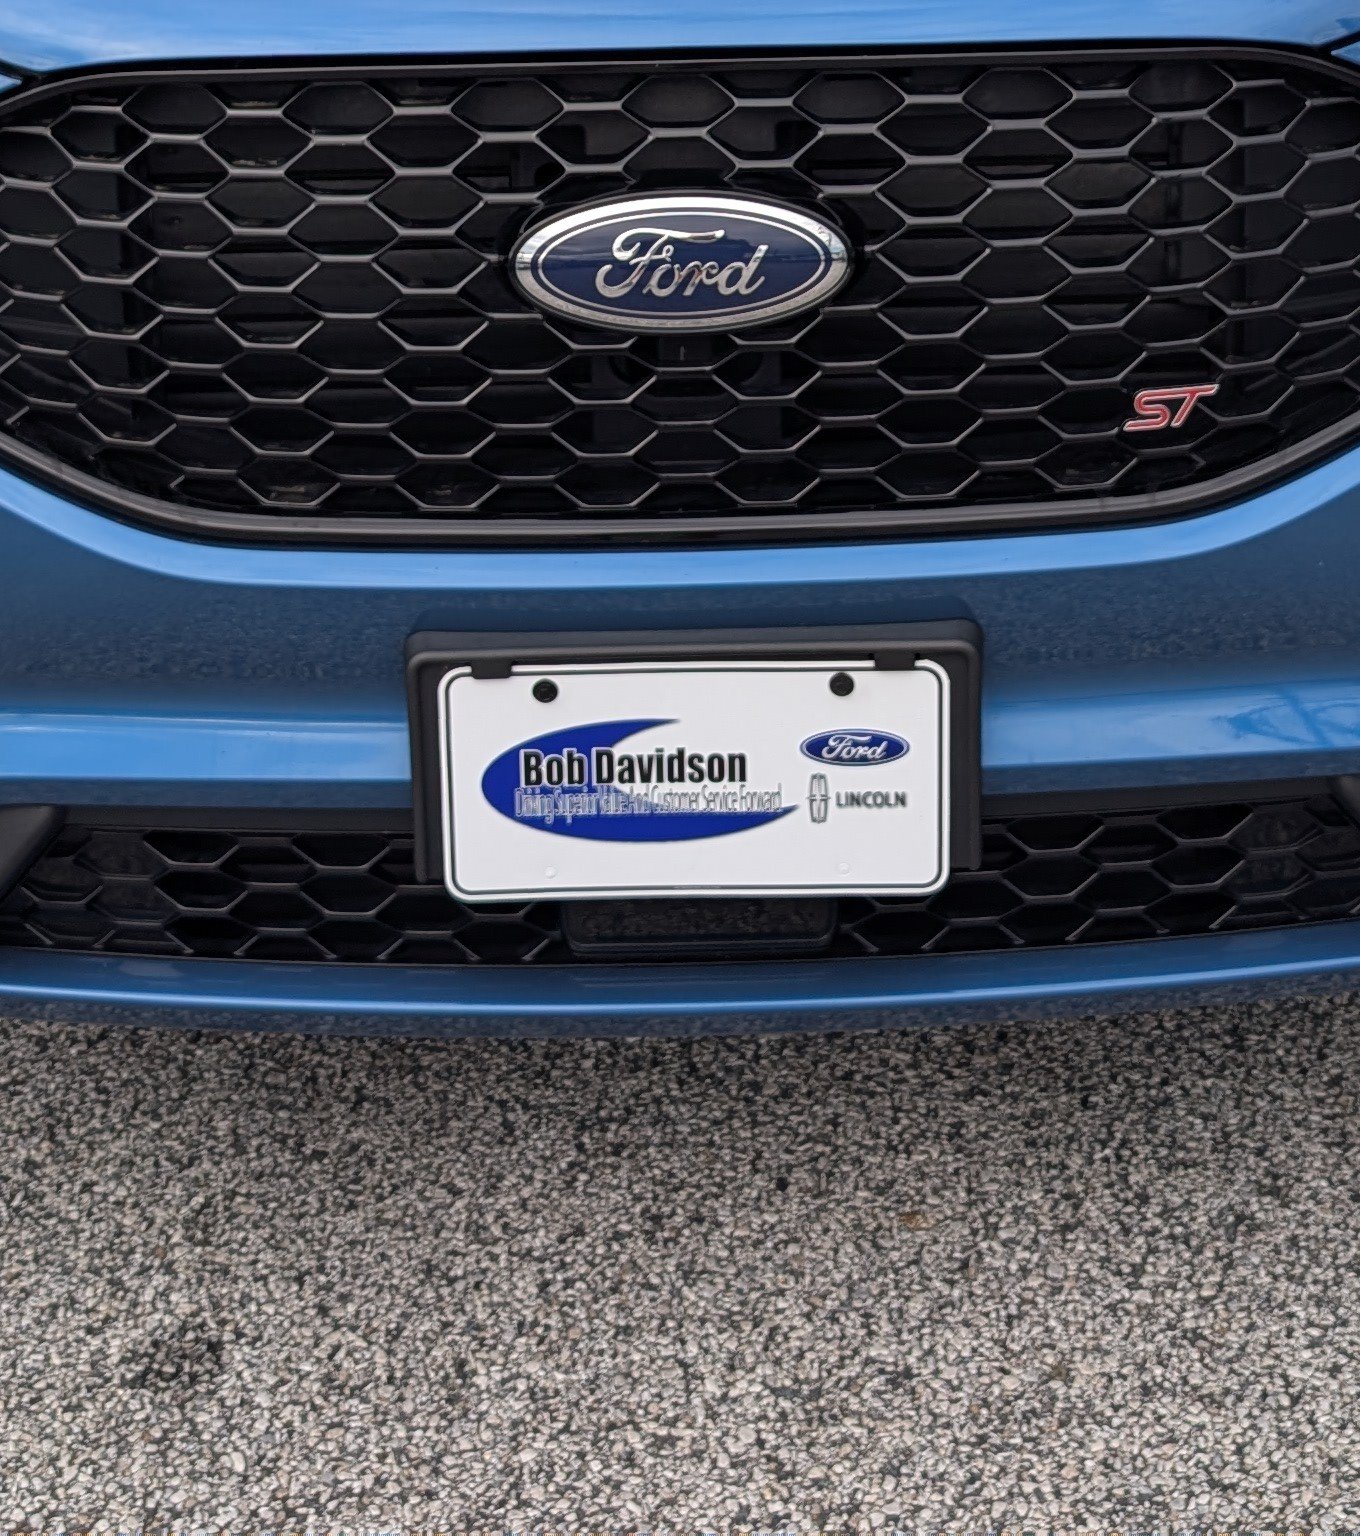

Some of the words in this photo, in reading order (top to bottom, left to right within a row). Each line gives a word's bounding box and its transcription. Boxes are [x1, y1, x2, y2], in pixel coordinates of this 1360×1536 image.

[595, 226, 769, 299] Ford
[1123, 383, 1220, 432] ST
[520, 748, 588, 787] Bob
[593, 747, 748, 785] Davidson
[821, 734, 888, 760] Ford
[554, 786, 598, 824] Superior
[650, 783, 701, 814] Customer
[701, 783, 739, 814] Service
[739, 782, 782, 813] Forward
[835, 790, 908, 809] LINCOLN
